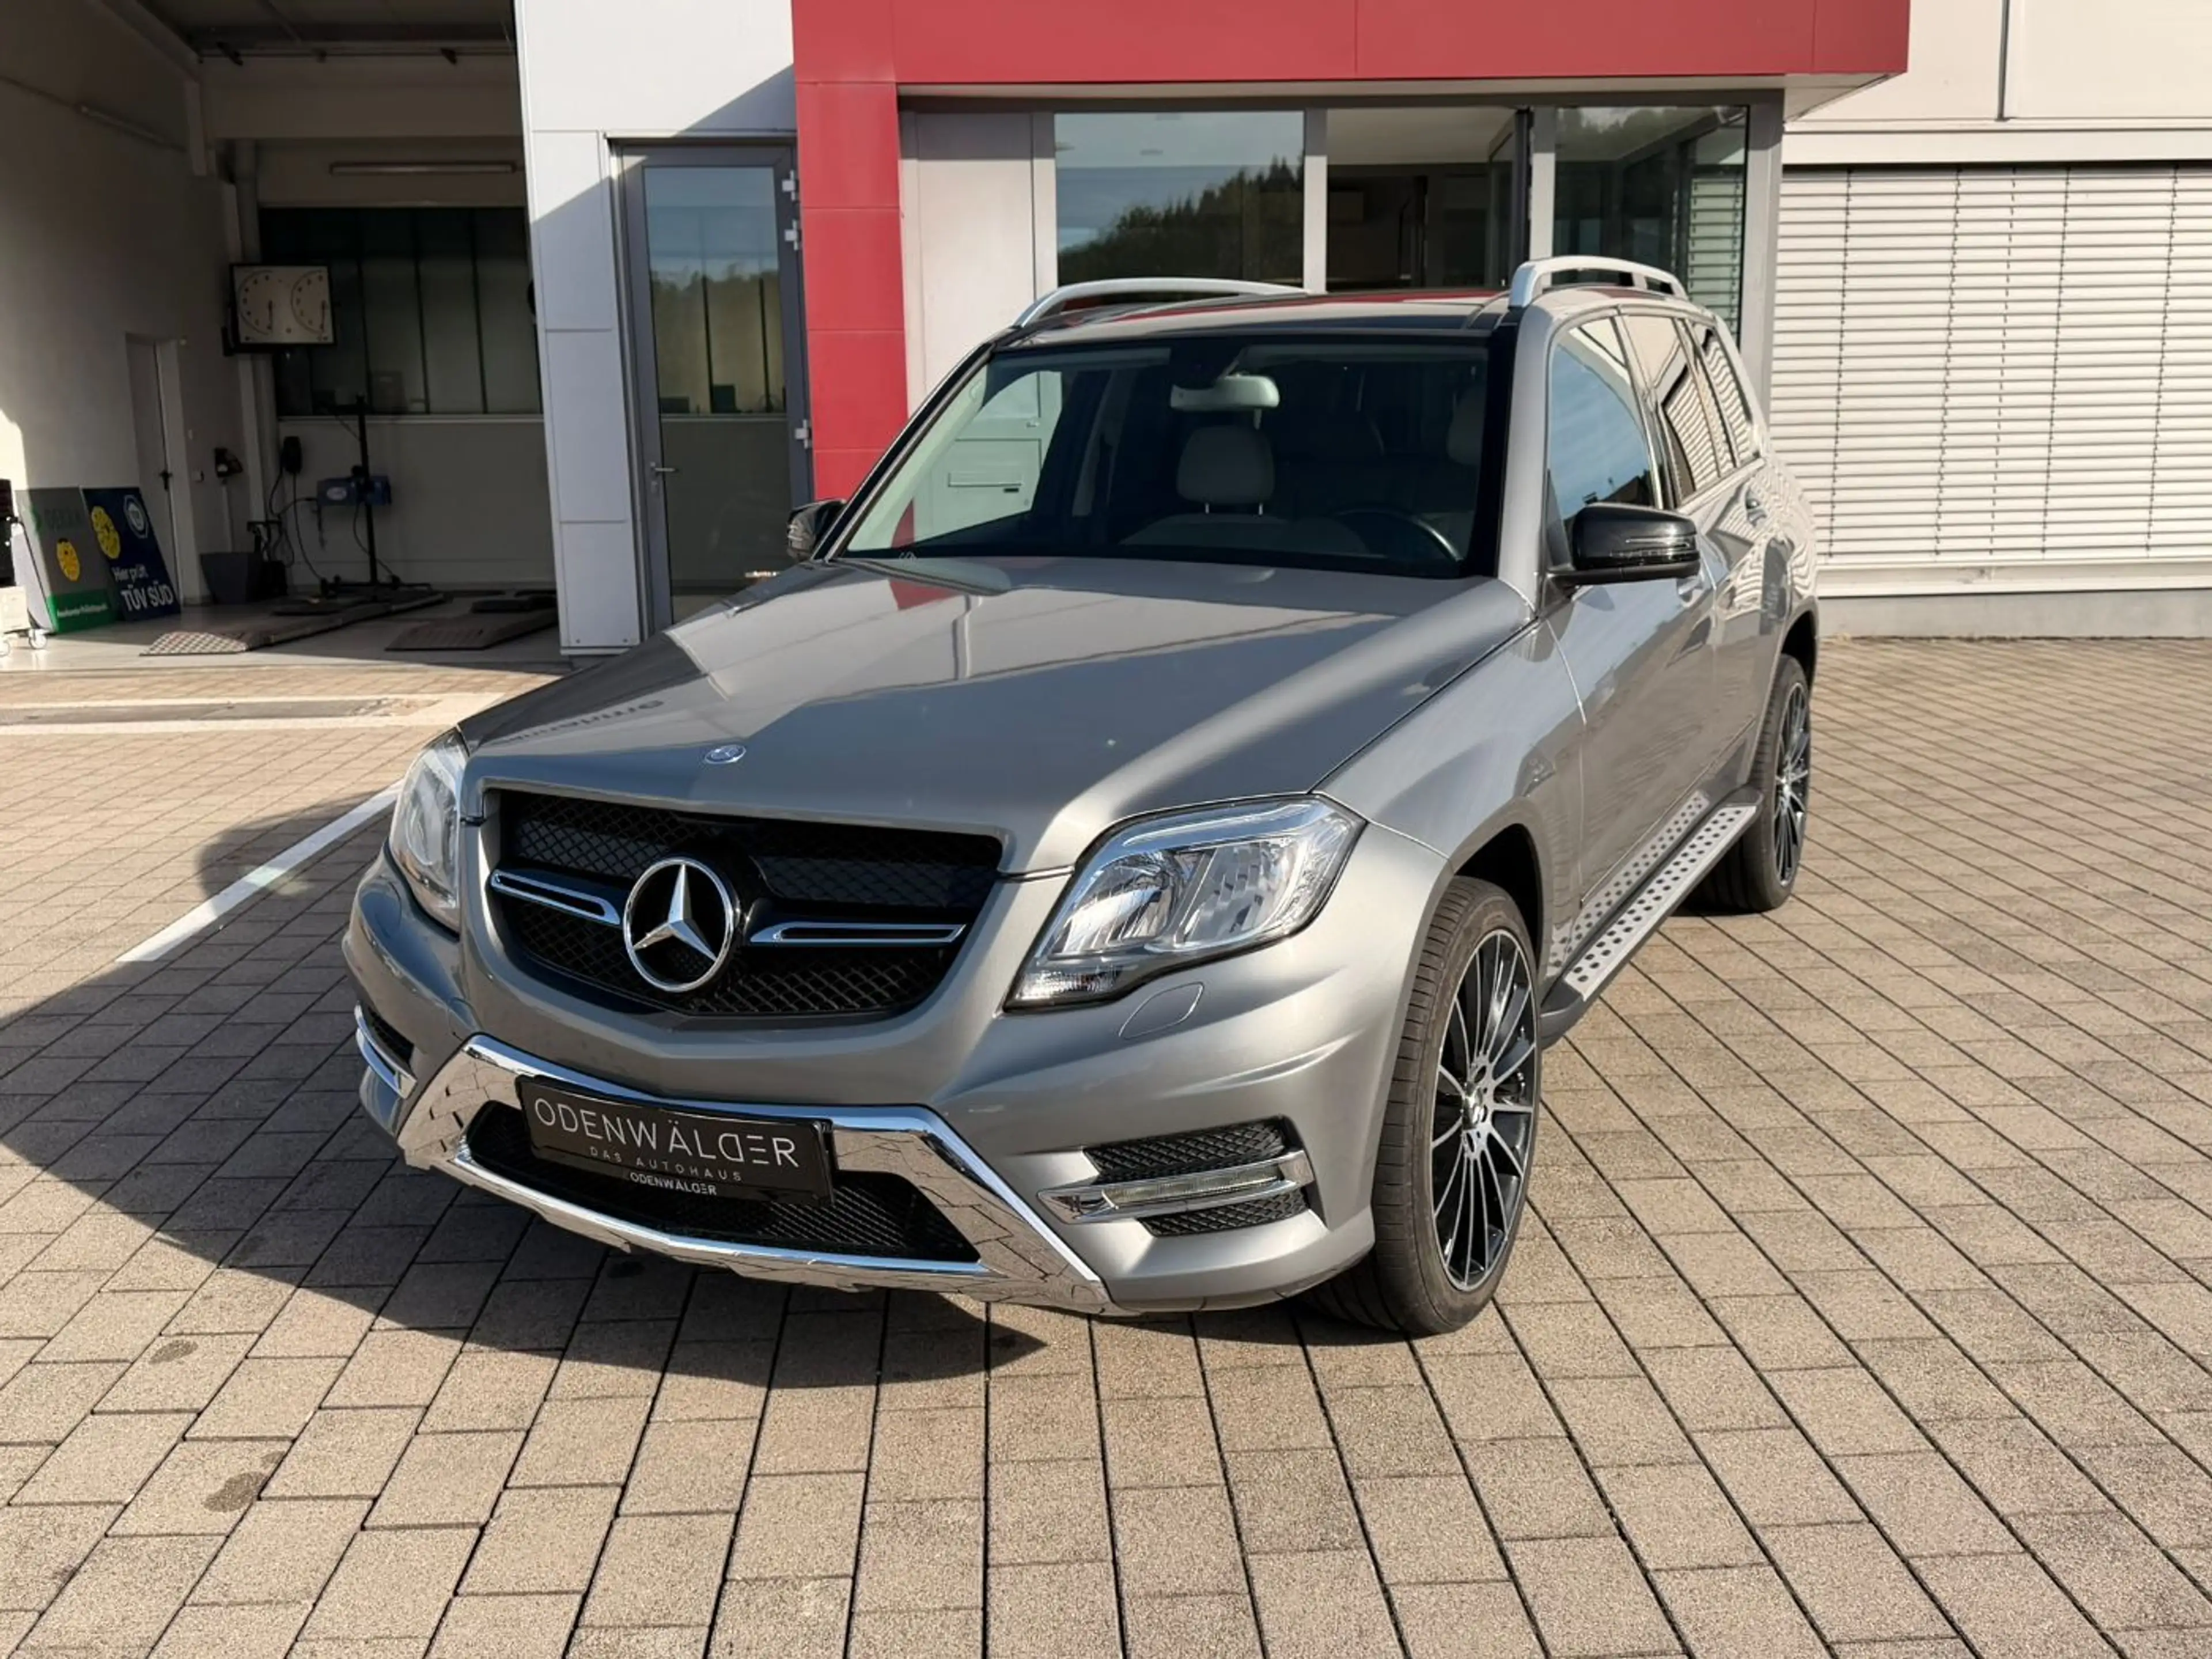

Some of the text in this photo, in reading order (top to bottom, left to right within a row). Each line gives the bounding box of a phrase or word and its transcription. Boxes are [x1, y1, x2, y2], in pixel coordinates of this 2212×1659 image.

[120, 584, 147, 611] TÜV
[147, 579, 173, 606] SÜD
[535, 1098, 799, 1168] ODENWÄLDER
[590, 1146, 741, 1182] DAS AUTOHAUS
